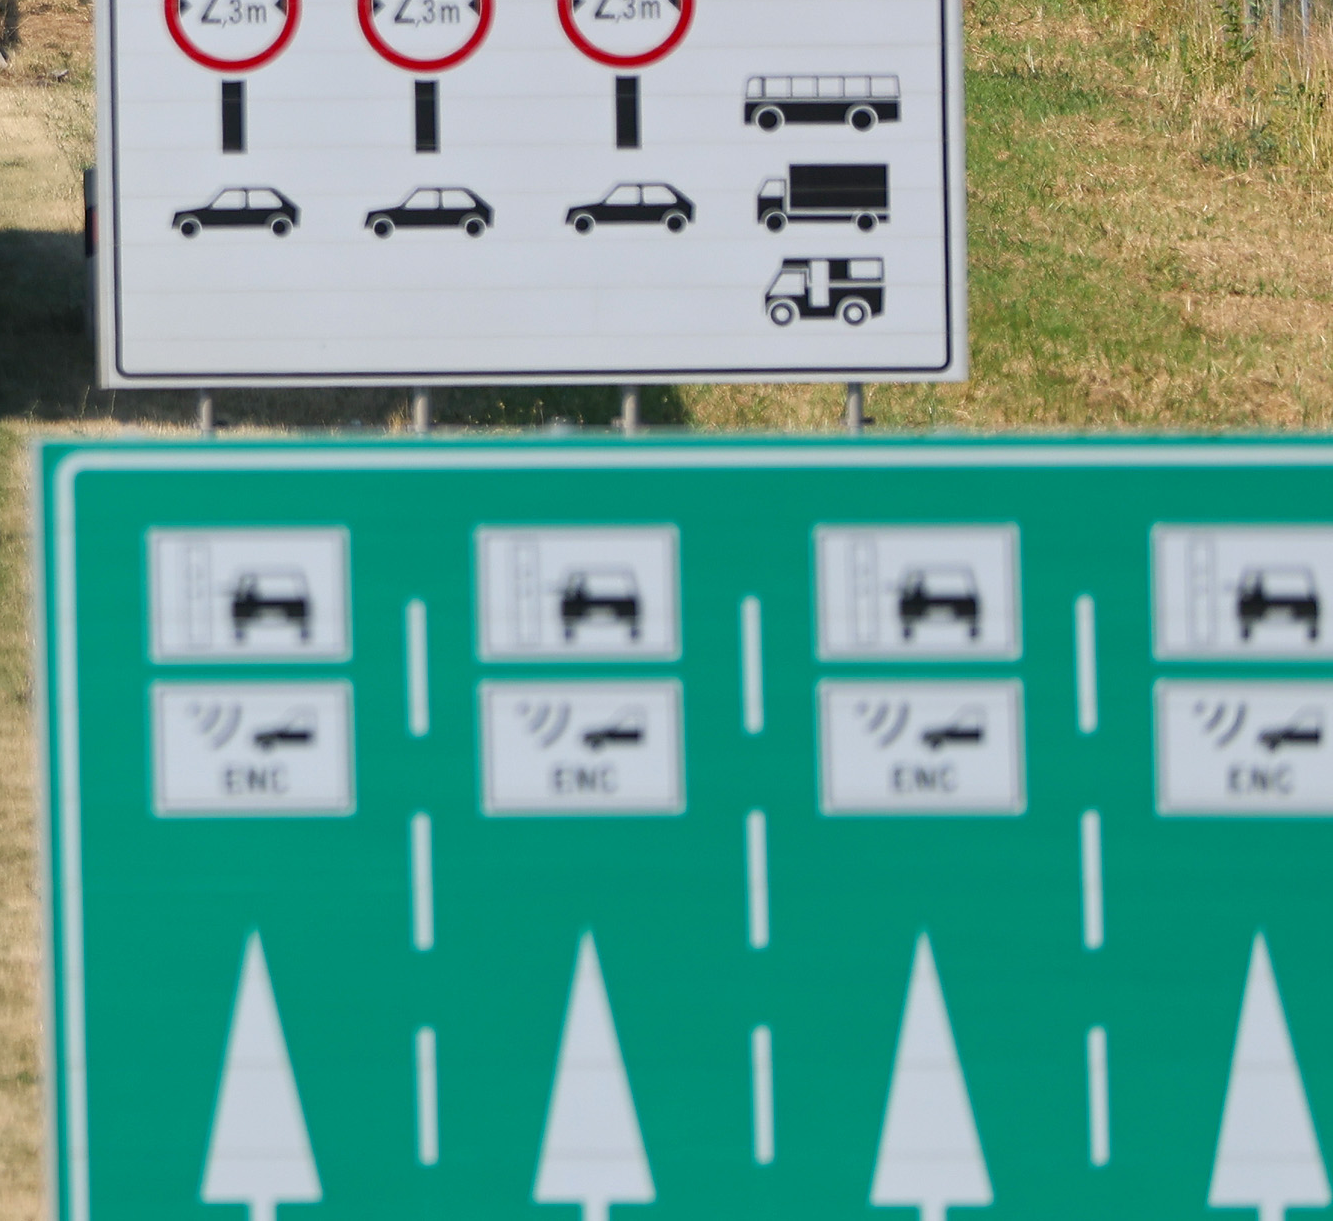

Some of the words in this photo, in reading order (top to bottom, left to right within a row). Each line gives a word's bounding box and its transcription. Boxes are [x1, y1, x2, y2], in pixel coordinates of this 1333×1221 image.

[223, 767, 290, 796] ENC
[551, 767, 618, 796] ENC
[891, 765, 959, 794] ENC
[1227, 765, 1295, 794] ENC
